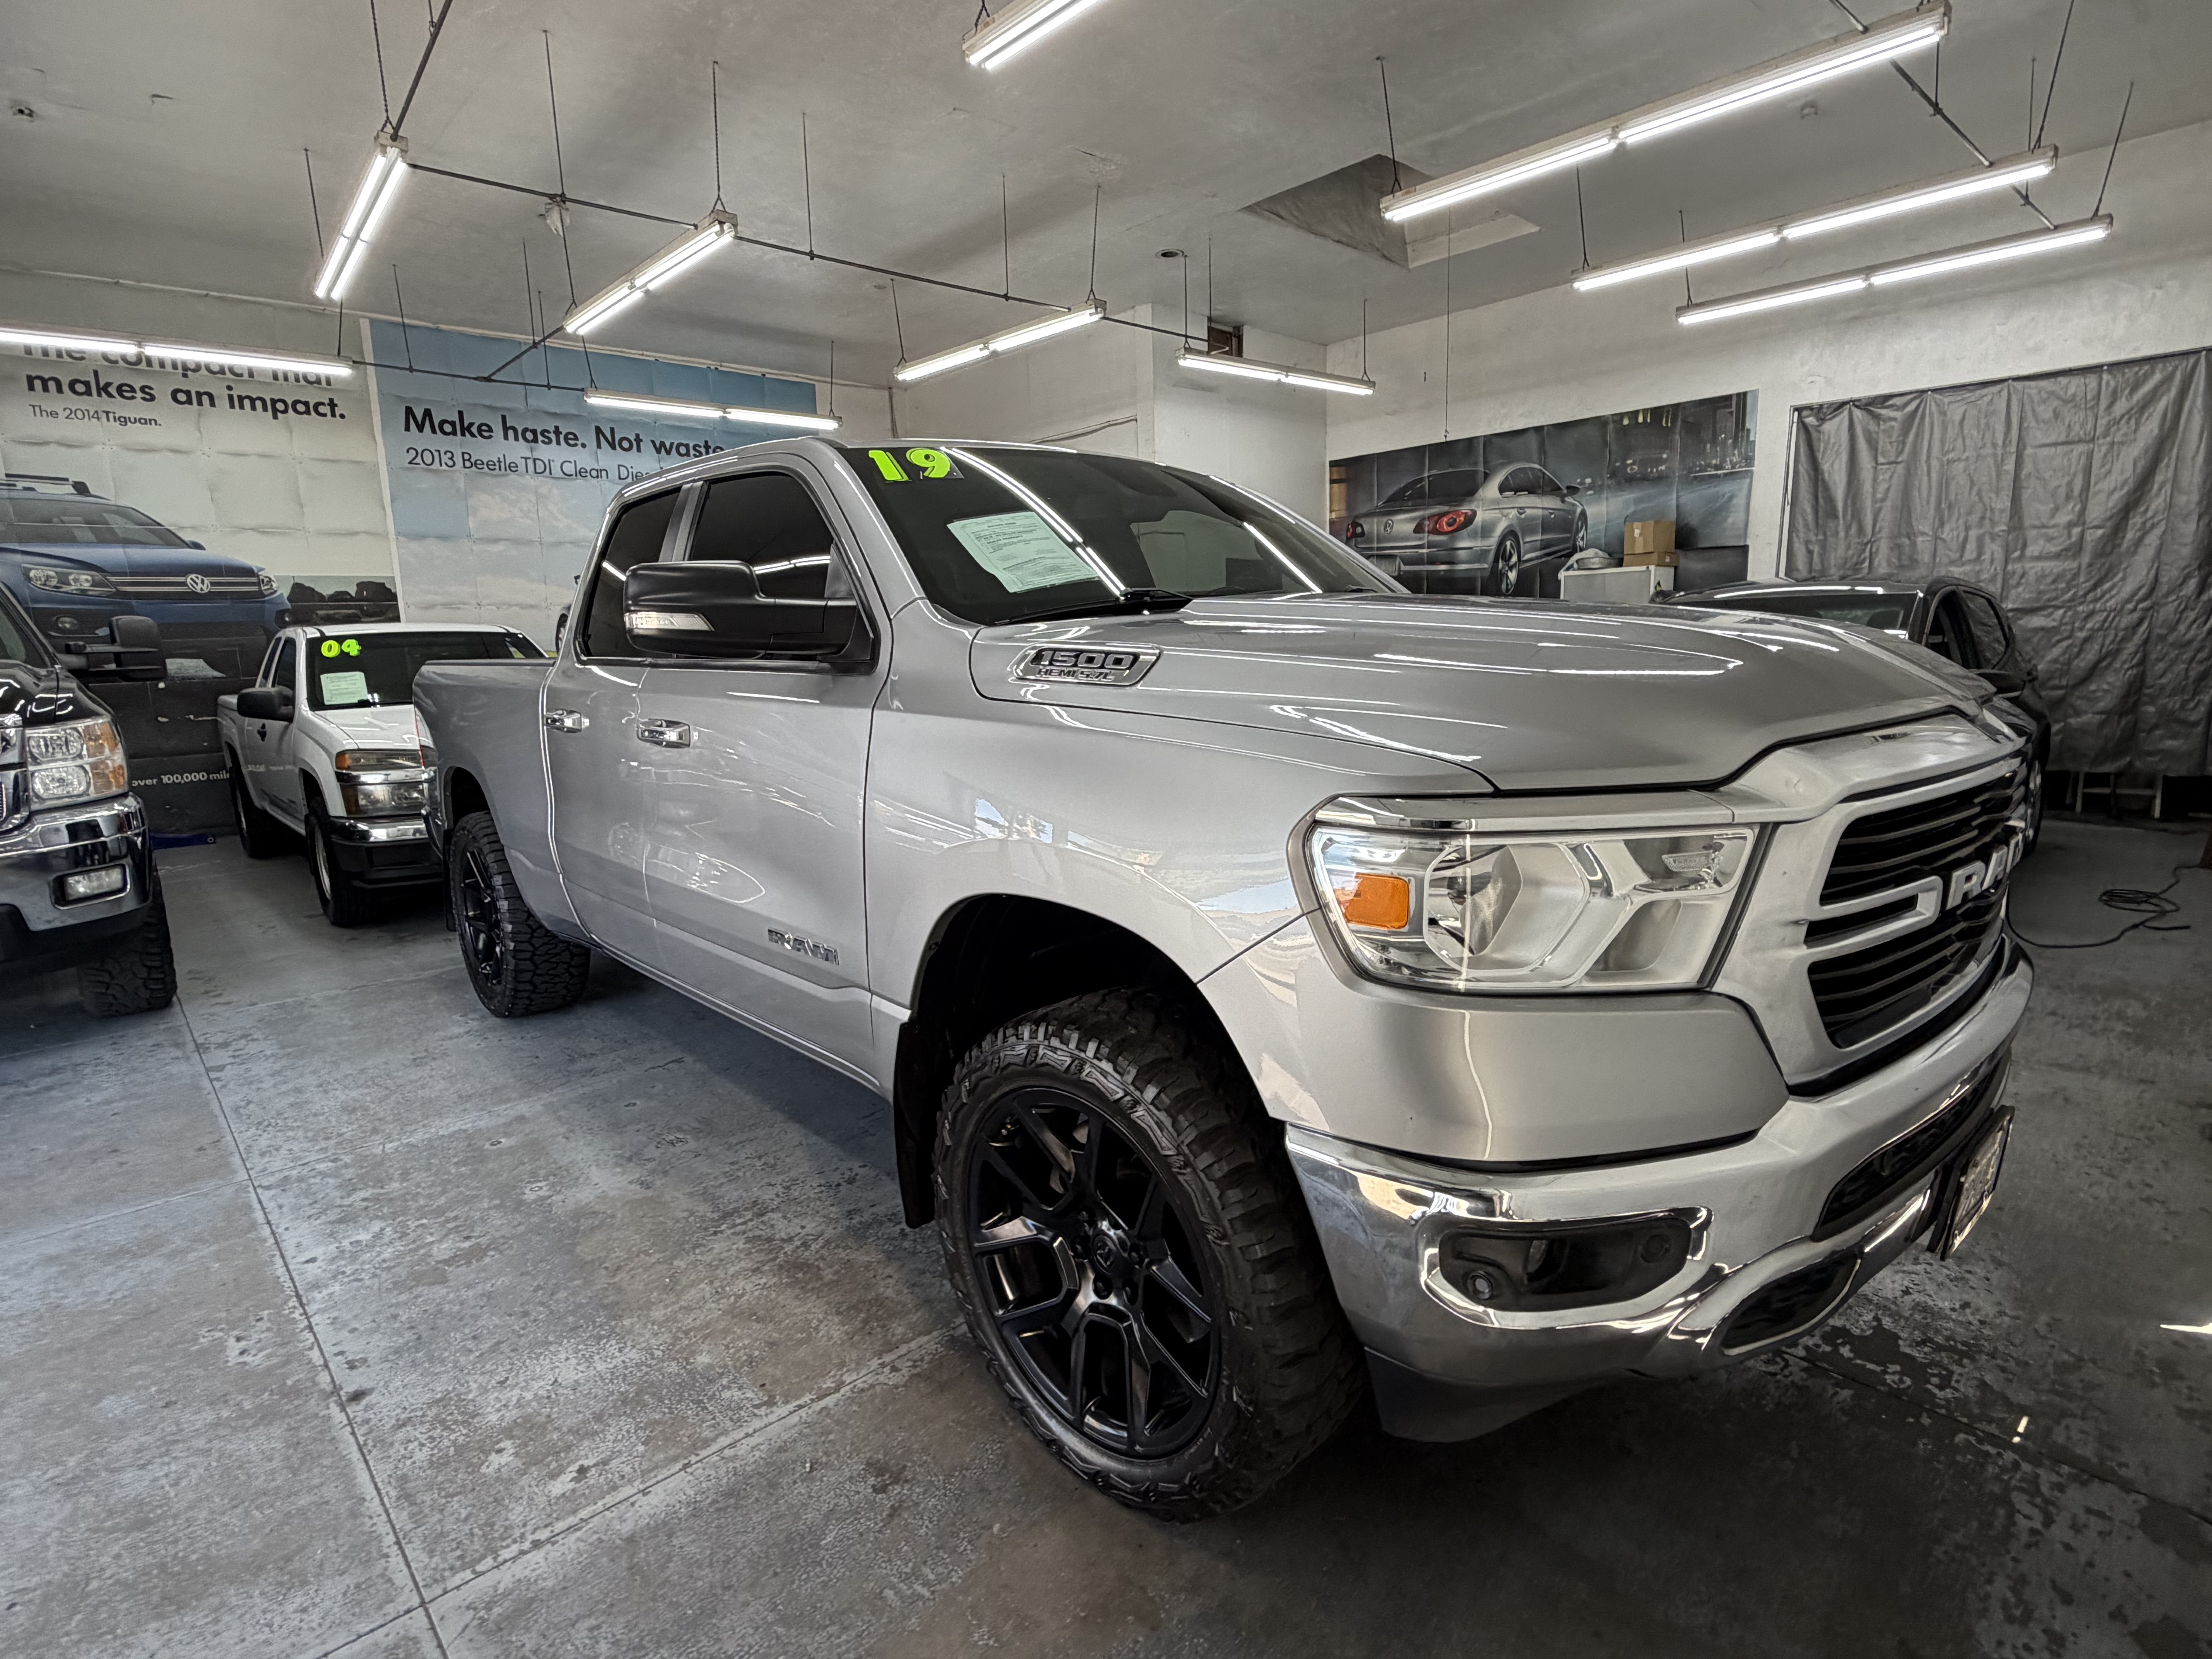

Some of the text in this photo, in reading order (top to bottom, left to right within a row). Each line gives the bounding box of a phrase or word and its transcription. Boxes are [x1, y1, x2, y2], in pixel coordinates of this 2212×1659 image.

[26, 369, 346, 420] makes an impact.
[29, 404, 161, 427] The 2014 Tiguan.
[404, 406, 493, 440] Make
[501, 414, 587, 448] haste.
[595, 425, 643, 453] Not
[406, 447, 456, 468] 2013
[462, 452, 519, 472] Beetle
[560, 460, 609, 479] Clean
[868, 448, 951, 481] 19
[321, 639, 362, 658] 04
[1040, 651, 1134, 669] 1500
[1036, 668, 1115, 682] HEMI 5.7L
[160, 772, 208, 784] 100,000
[1945, 832, 2024, 911] RAM
[767, 927, 840, 966] RAM
